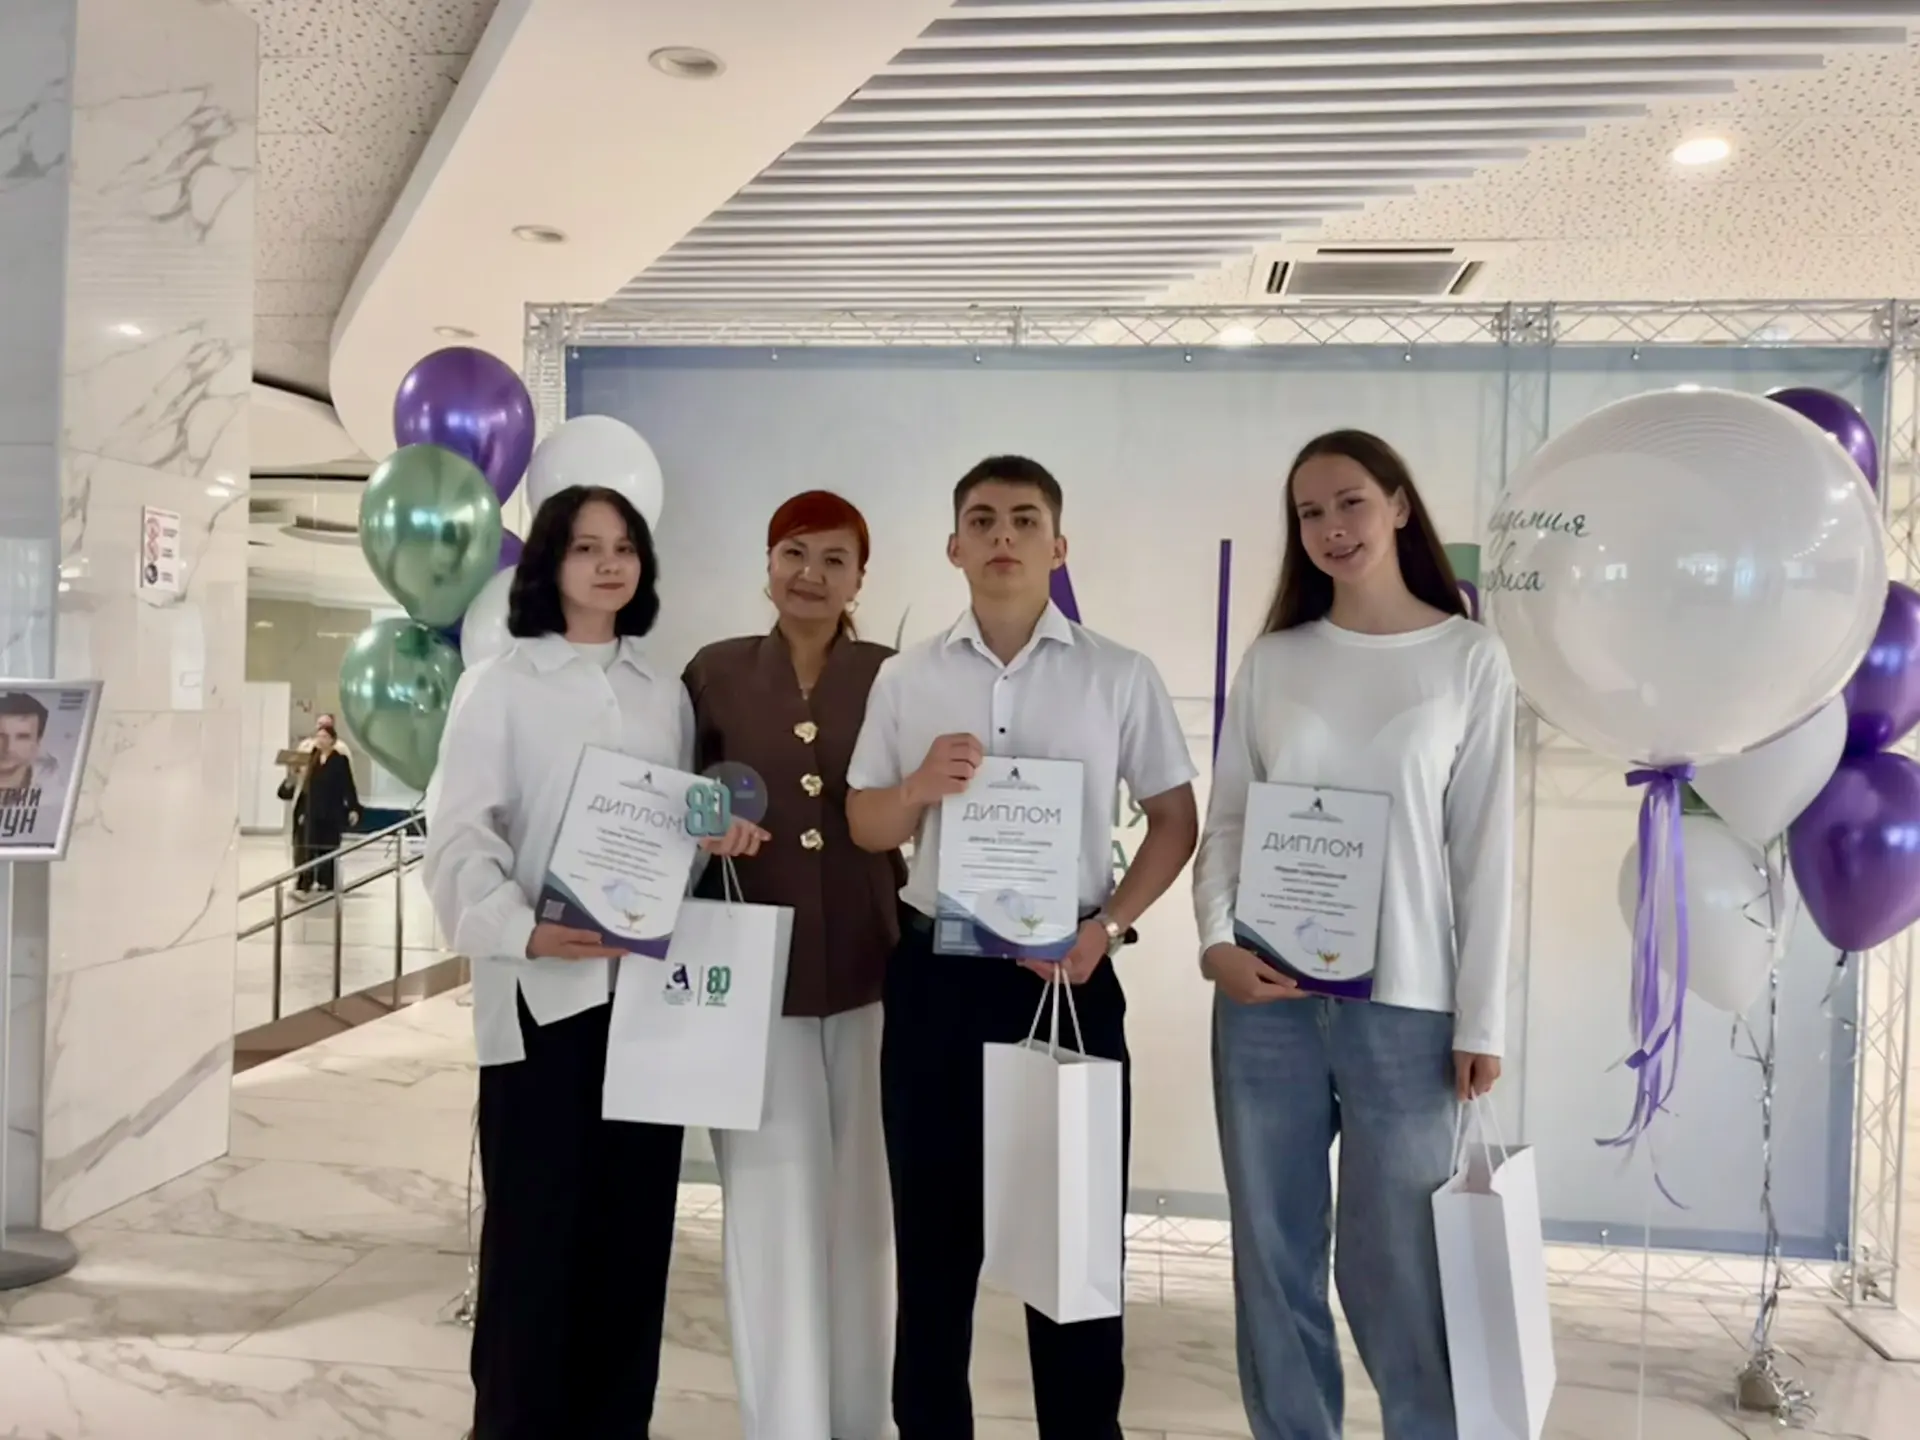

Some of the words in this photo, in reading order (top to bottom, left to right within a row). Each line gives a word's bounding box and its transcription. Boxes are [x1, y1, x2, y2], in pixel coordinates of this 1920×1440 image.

[587, 794, 683, 834] ДИПЛОМ
[686, 781, 732, 838] 80
[962, 802, 1062, 826] ДИПЛОМ
[1261, 832, 1364, 859] ДИПЛОМ
[706, 965, 732, 995] 80
